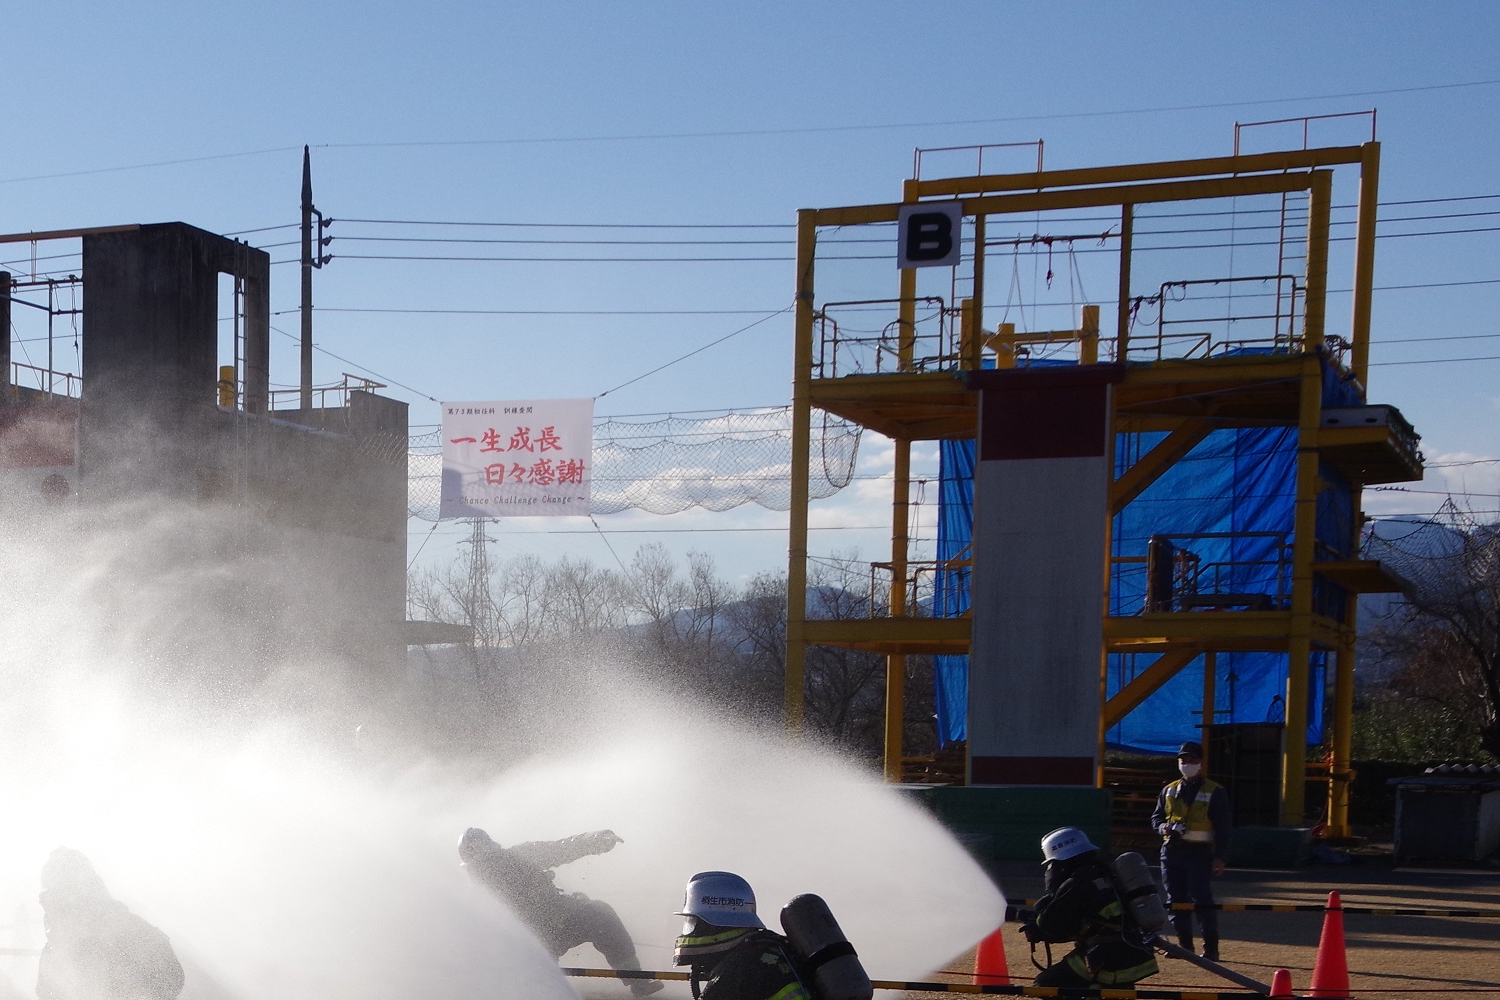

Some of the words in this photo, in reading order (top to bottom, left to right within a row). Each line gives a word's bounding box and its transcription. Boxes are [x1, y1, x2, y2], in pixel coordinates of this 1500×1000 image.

[906, 212, 953, 261] B
[450, 425, 563, 453] 一生成長
[484, 458, 585, 486] 日々感謝
[459, 496, 489, 505] Chance
[493, 495, 537, 505] Challenge
[541, 494, 572, 504] Change
